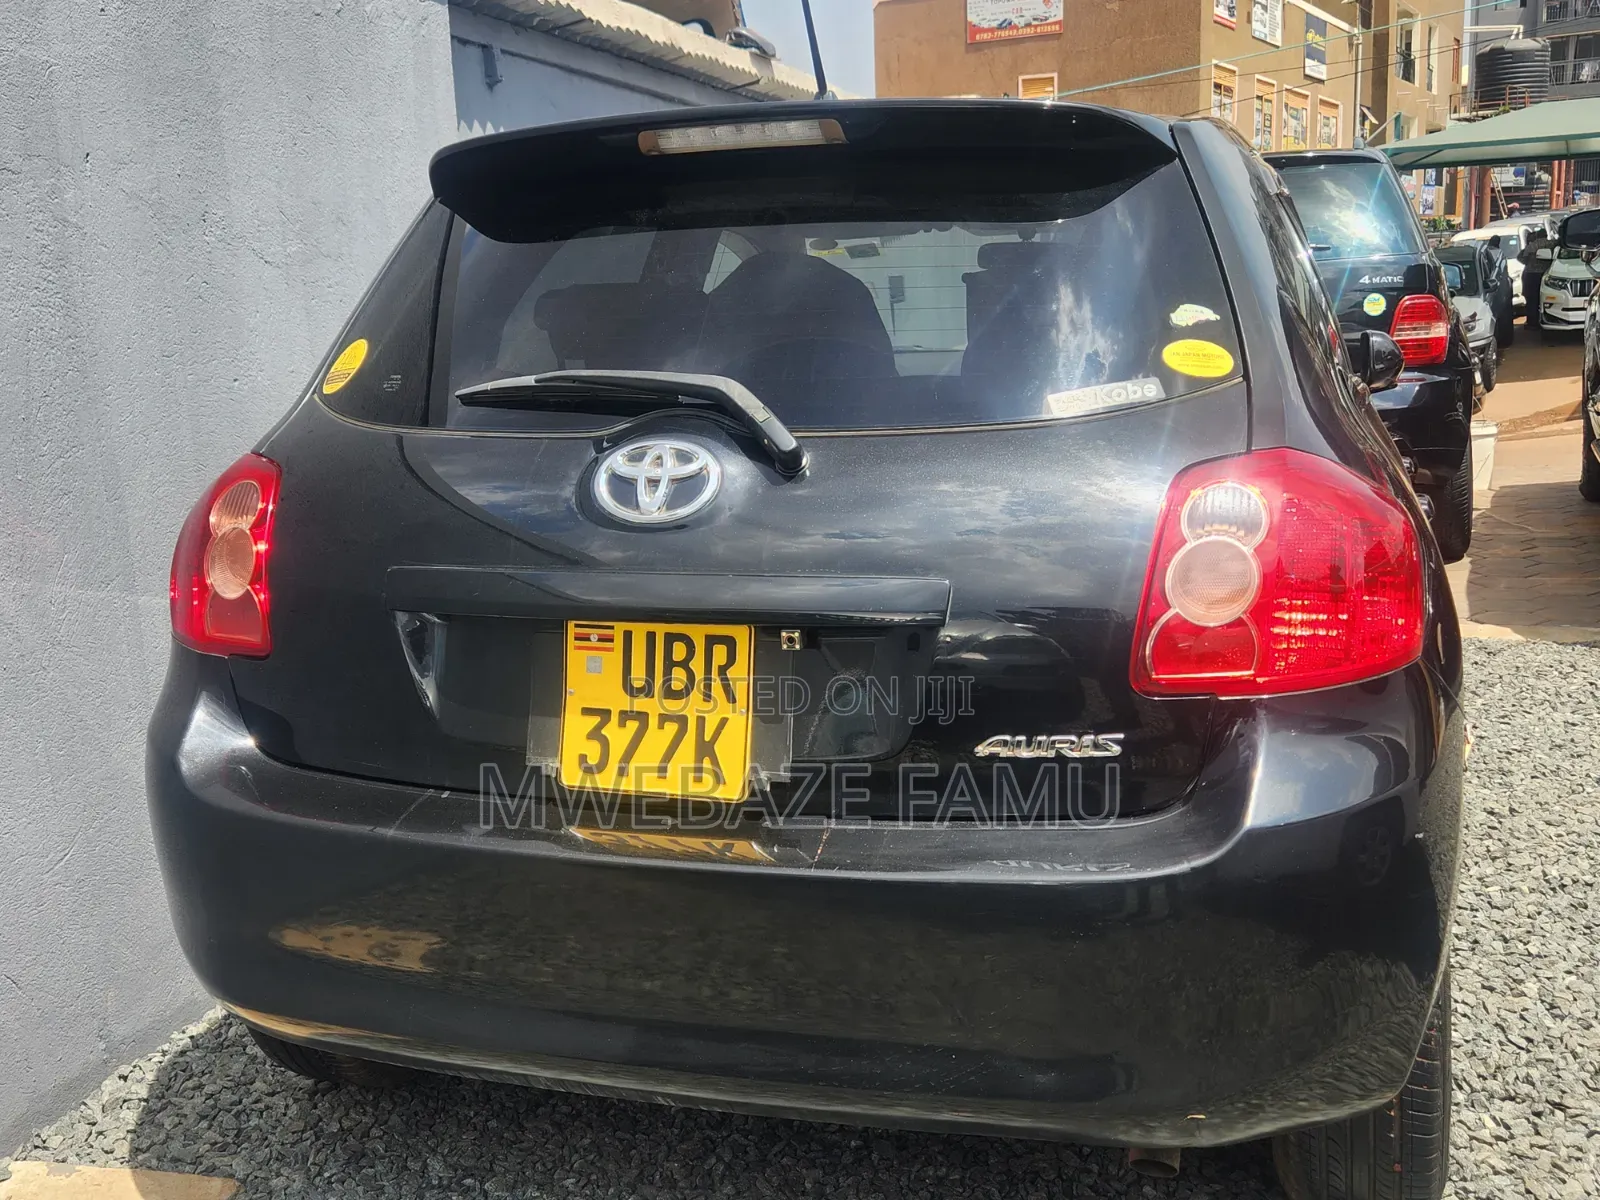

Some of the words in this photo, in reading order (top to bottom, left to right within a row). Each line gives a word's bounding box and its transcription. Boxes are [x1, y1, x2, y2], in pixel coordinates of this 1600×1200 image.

[1094, 383, 1157, 404] Kobe
[621, 630, 737, 704] UBR
[578, 706, 730, 785] 377K
[974, 733, 1125, 758] AURIS
